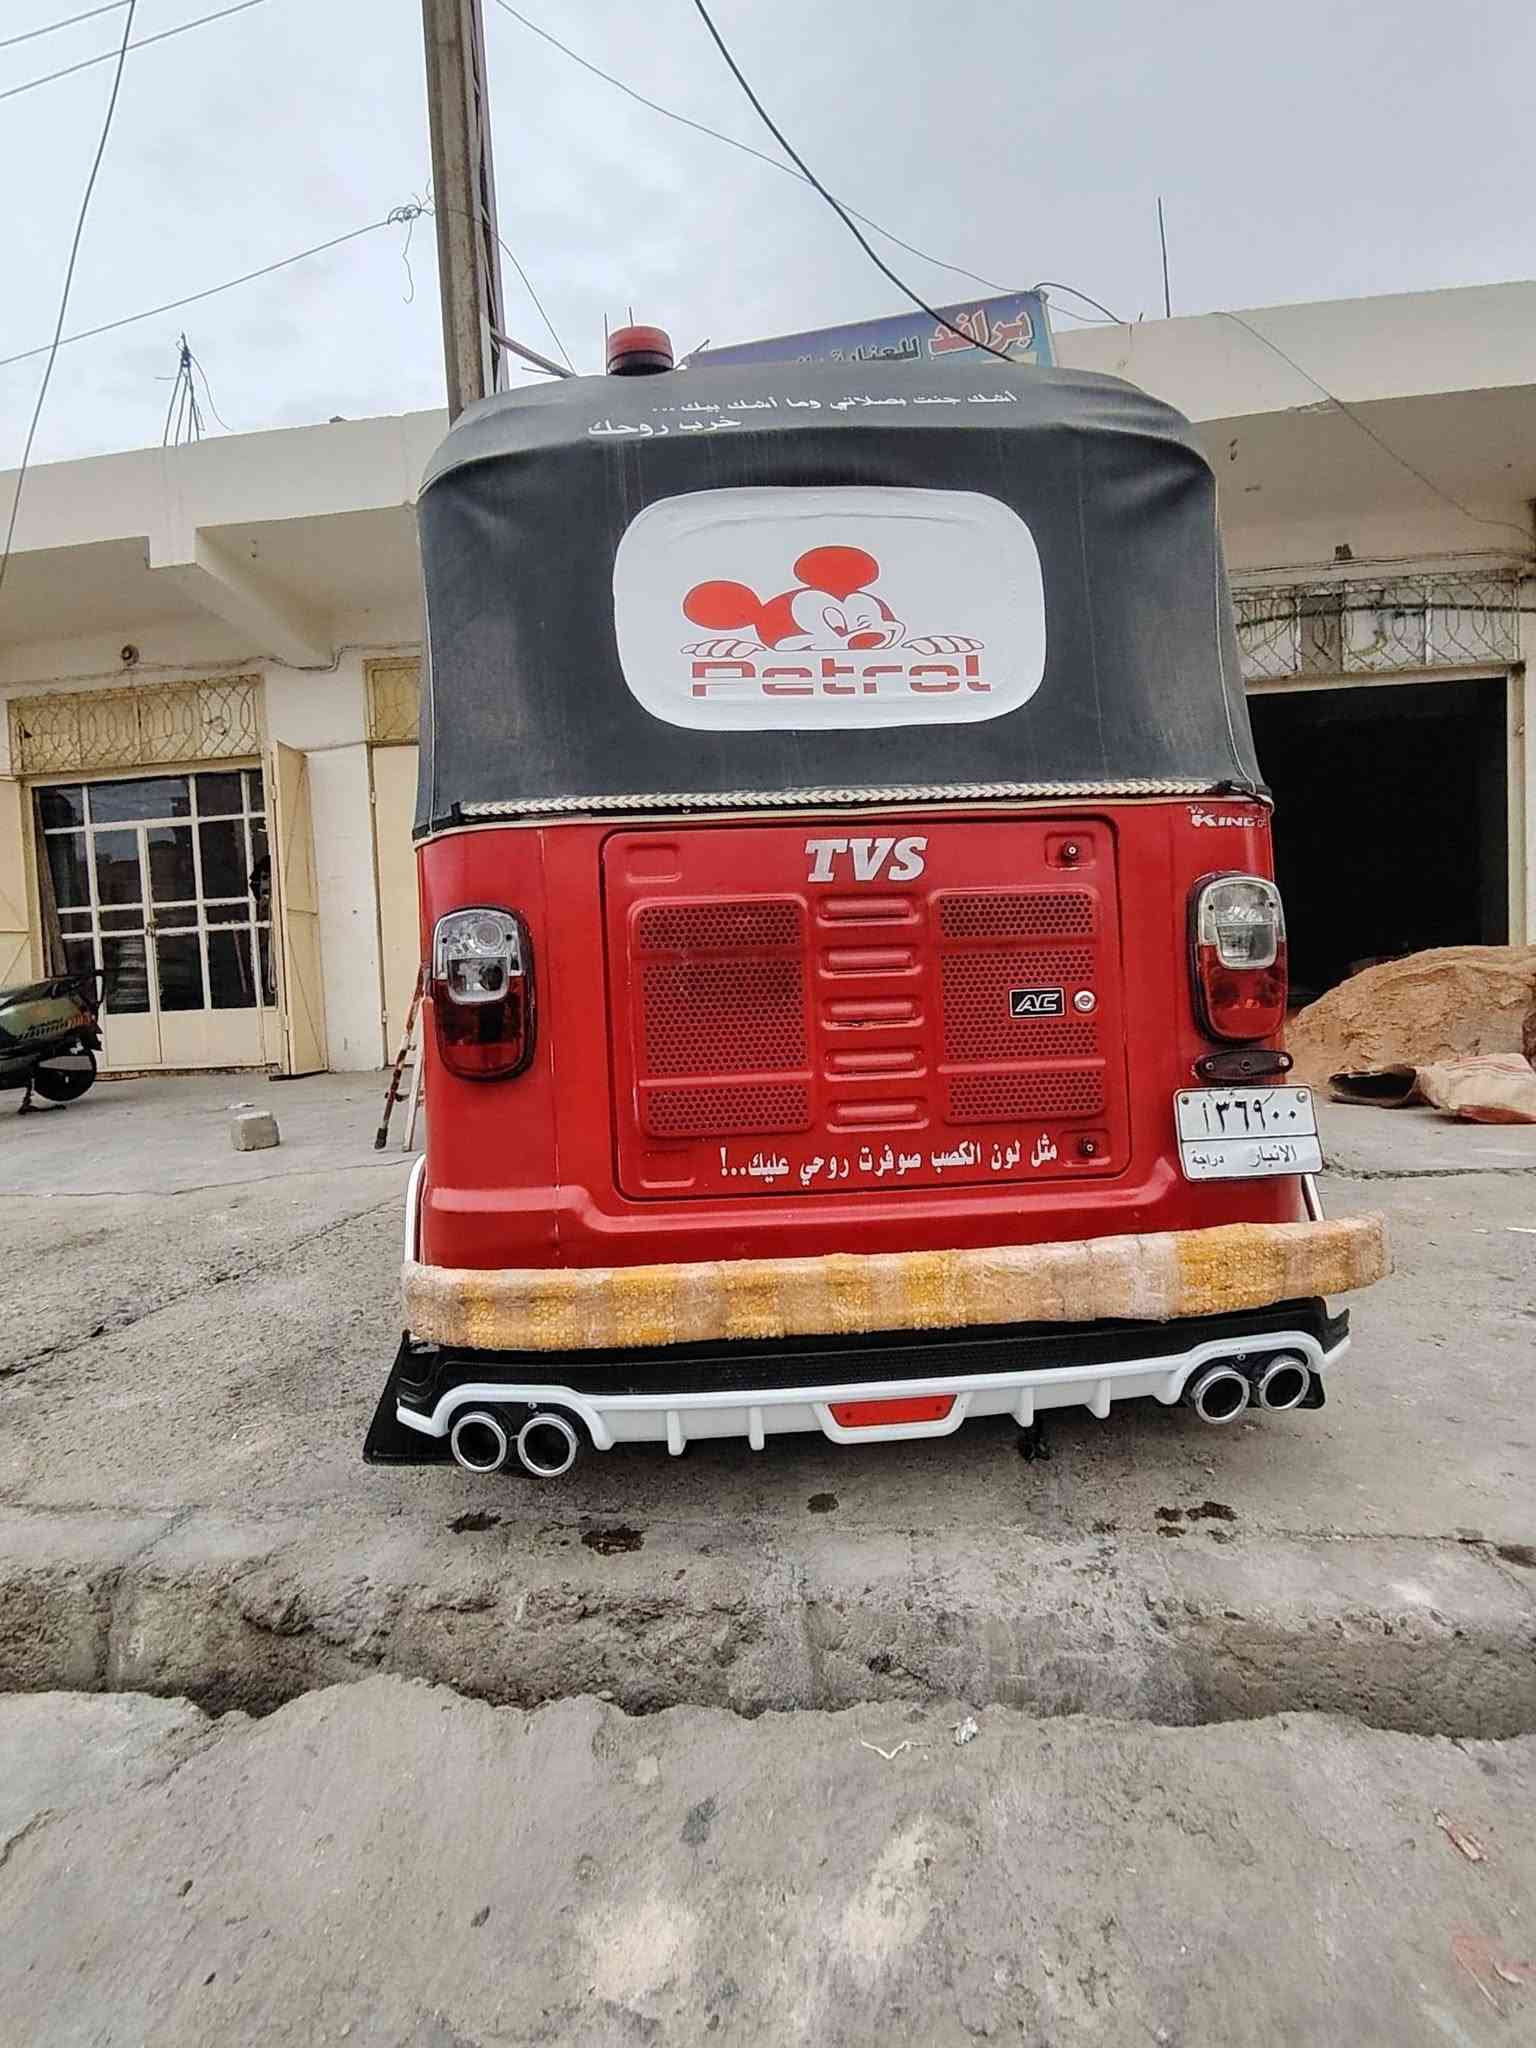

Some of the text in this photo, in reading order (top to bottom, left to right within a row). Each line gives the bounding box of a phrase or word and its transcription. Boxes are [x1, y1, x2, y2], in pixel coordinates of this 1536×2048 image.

[588, 419, 670, 437] روحك
[691, 654, 992, 697] Petrol
[804, 837, 928, 882] TVS
[991, 1139, 1021, 1170] لون
[1031, 1133, 1058, 1167] مثل
[1191, 1149, 1225, 1170] دراجة
[800, 1154, 850, 1186] روحي
